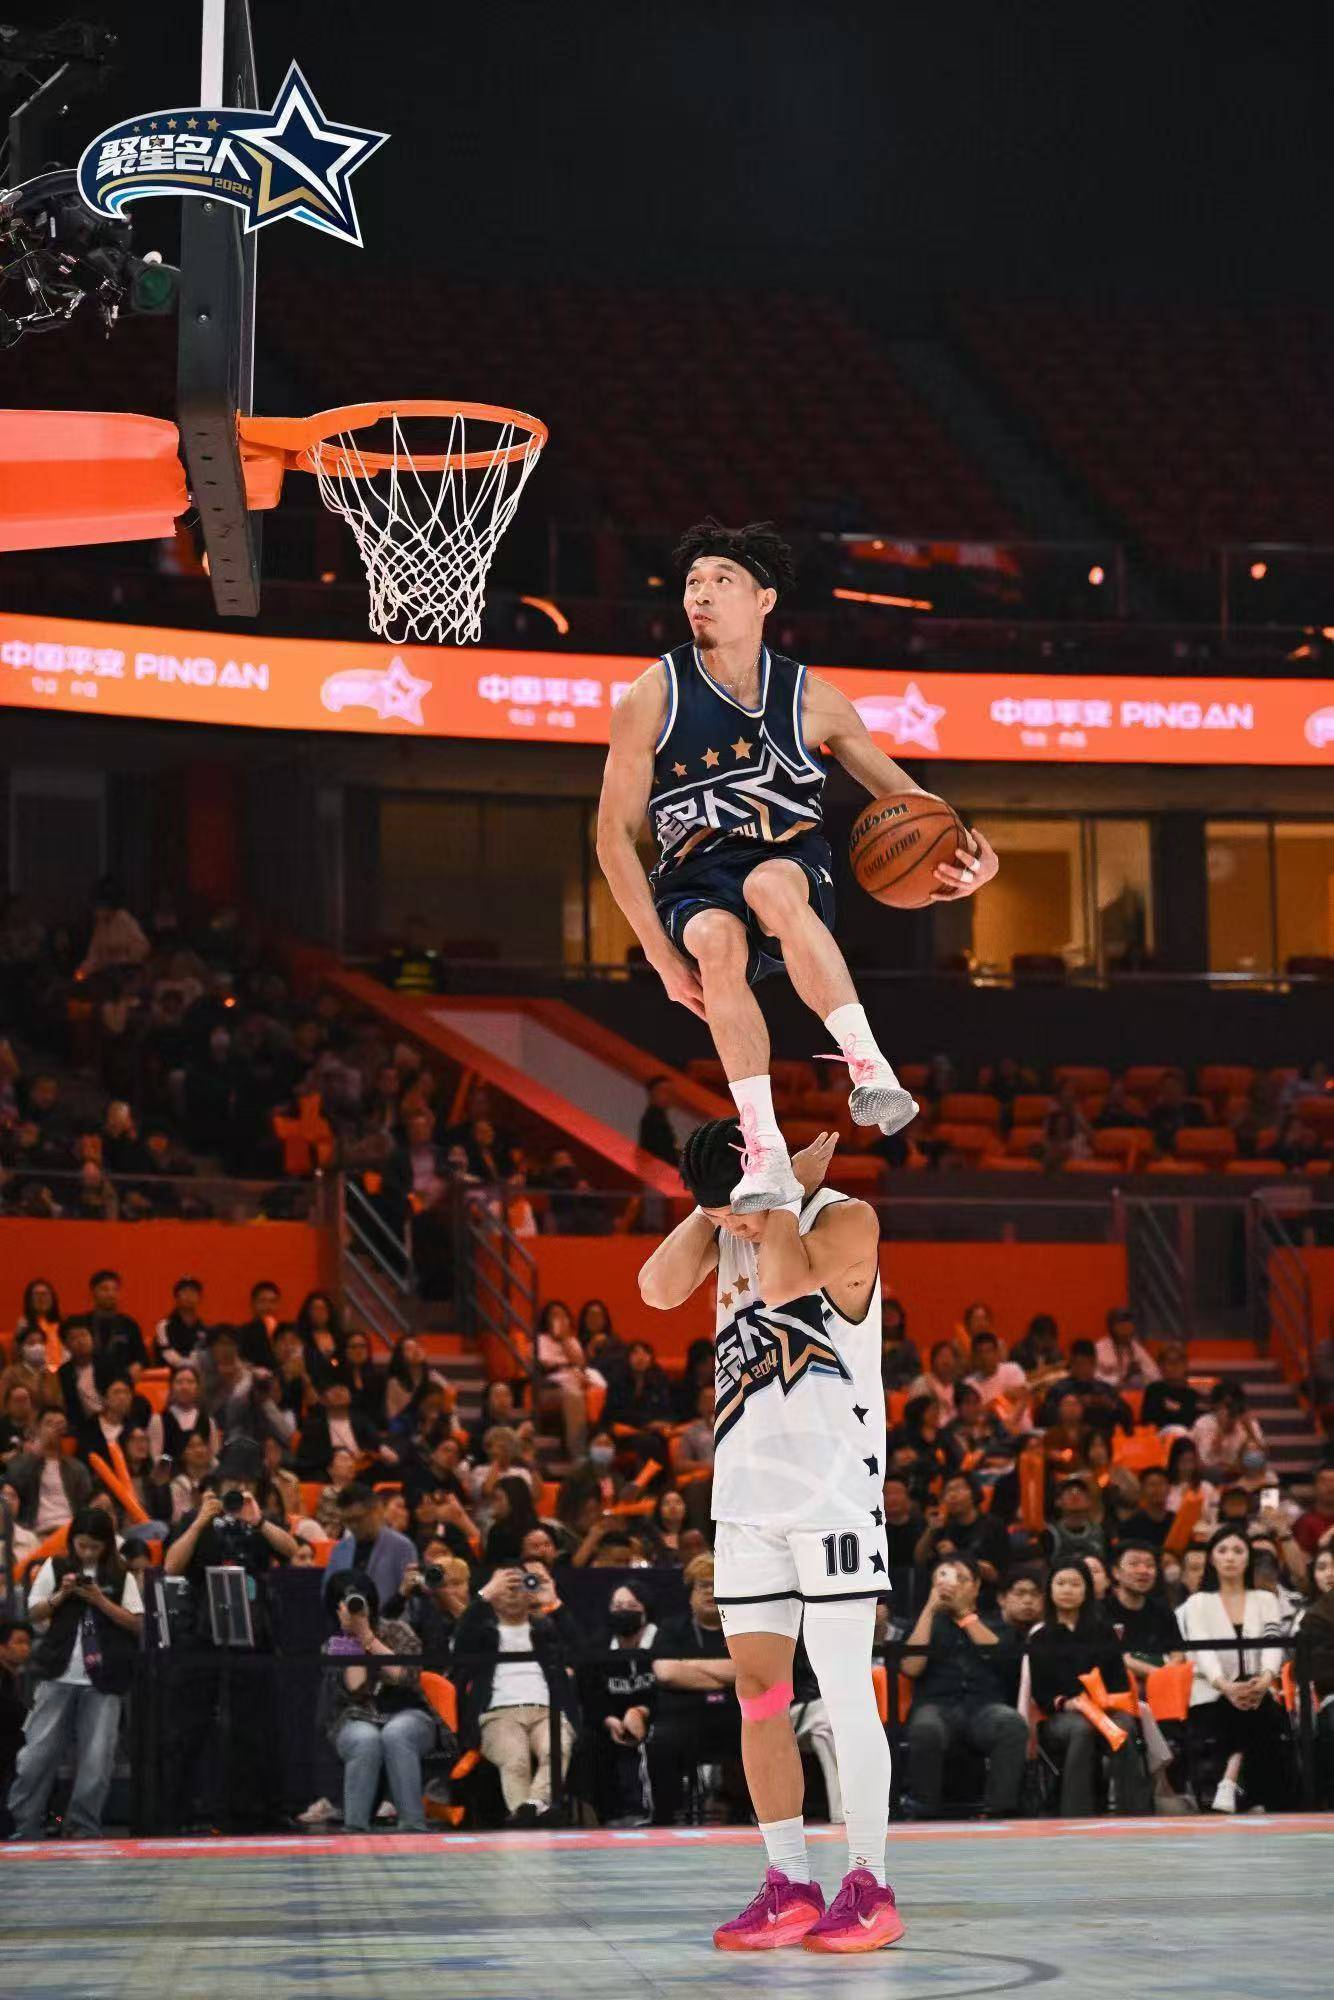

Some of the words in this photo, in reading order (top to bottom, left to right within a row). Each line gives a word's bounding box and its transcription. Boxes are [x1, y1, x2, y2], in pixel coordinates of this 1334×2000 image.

[96, 134, 251, 181] 聚星名人
[214, 177, 254, 200] 2024
[1, 640, 126, 679] 中国平安
[134, 652, 270, 692] PINGAN
[478, 674, 602, 708] 中国平安
[990, 697, 1112, 728] 中国平安
[1119, 701, 1254, 730] PINGAN
[822, 1532, 860, 1576] 10
